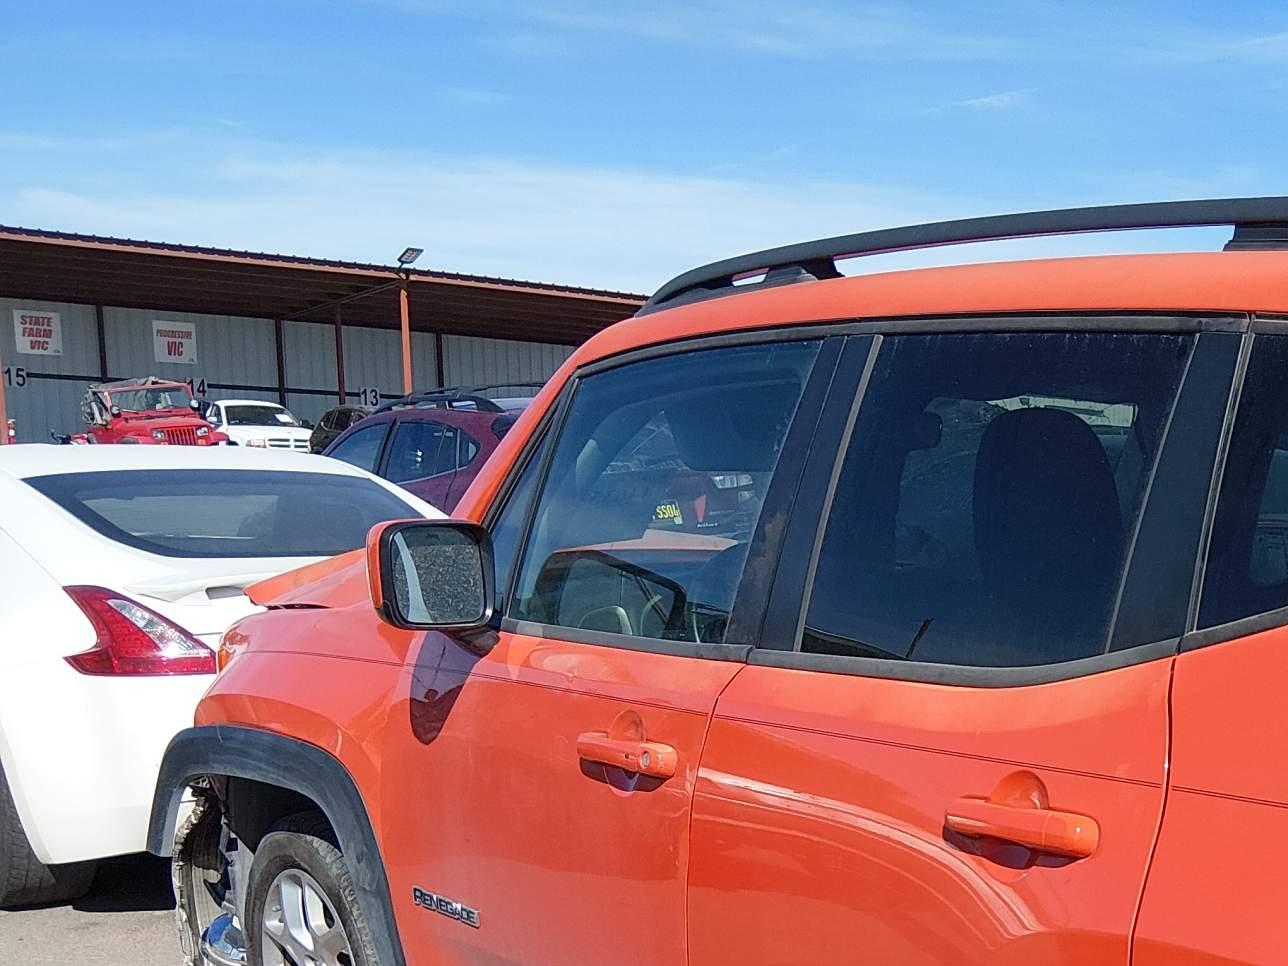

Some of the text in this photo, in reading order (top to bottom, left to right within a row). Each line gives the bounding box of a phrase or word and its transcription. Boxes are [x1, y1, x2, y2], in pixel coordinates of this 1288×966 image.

[20, 314, 53, 327] STATE
[22, 326, 53, 339] FARM
[156, 328, 193, 340] PROGRESSIVE
[29, 339, 49, 351] VIC
[167, 341, 184, 357] VIC
[4, 367, 27, 387] 15
[188, 377, 208, 398] 14
[361, 387, 380, 407] 13
[413, 885, 481, 928] RENEGADE
